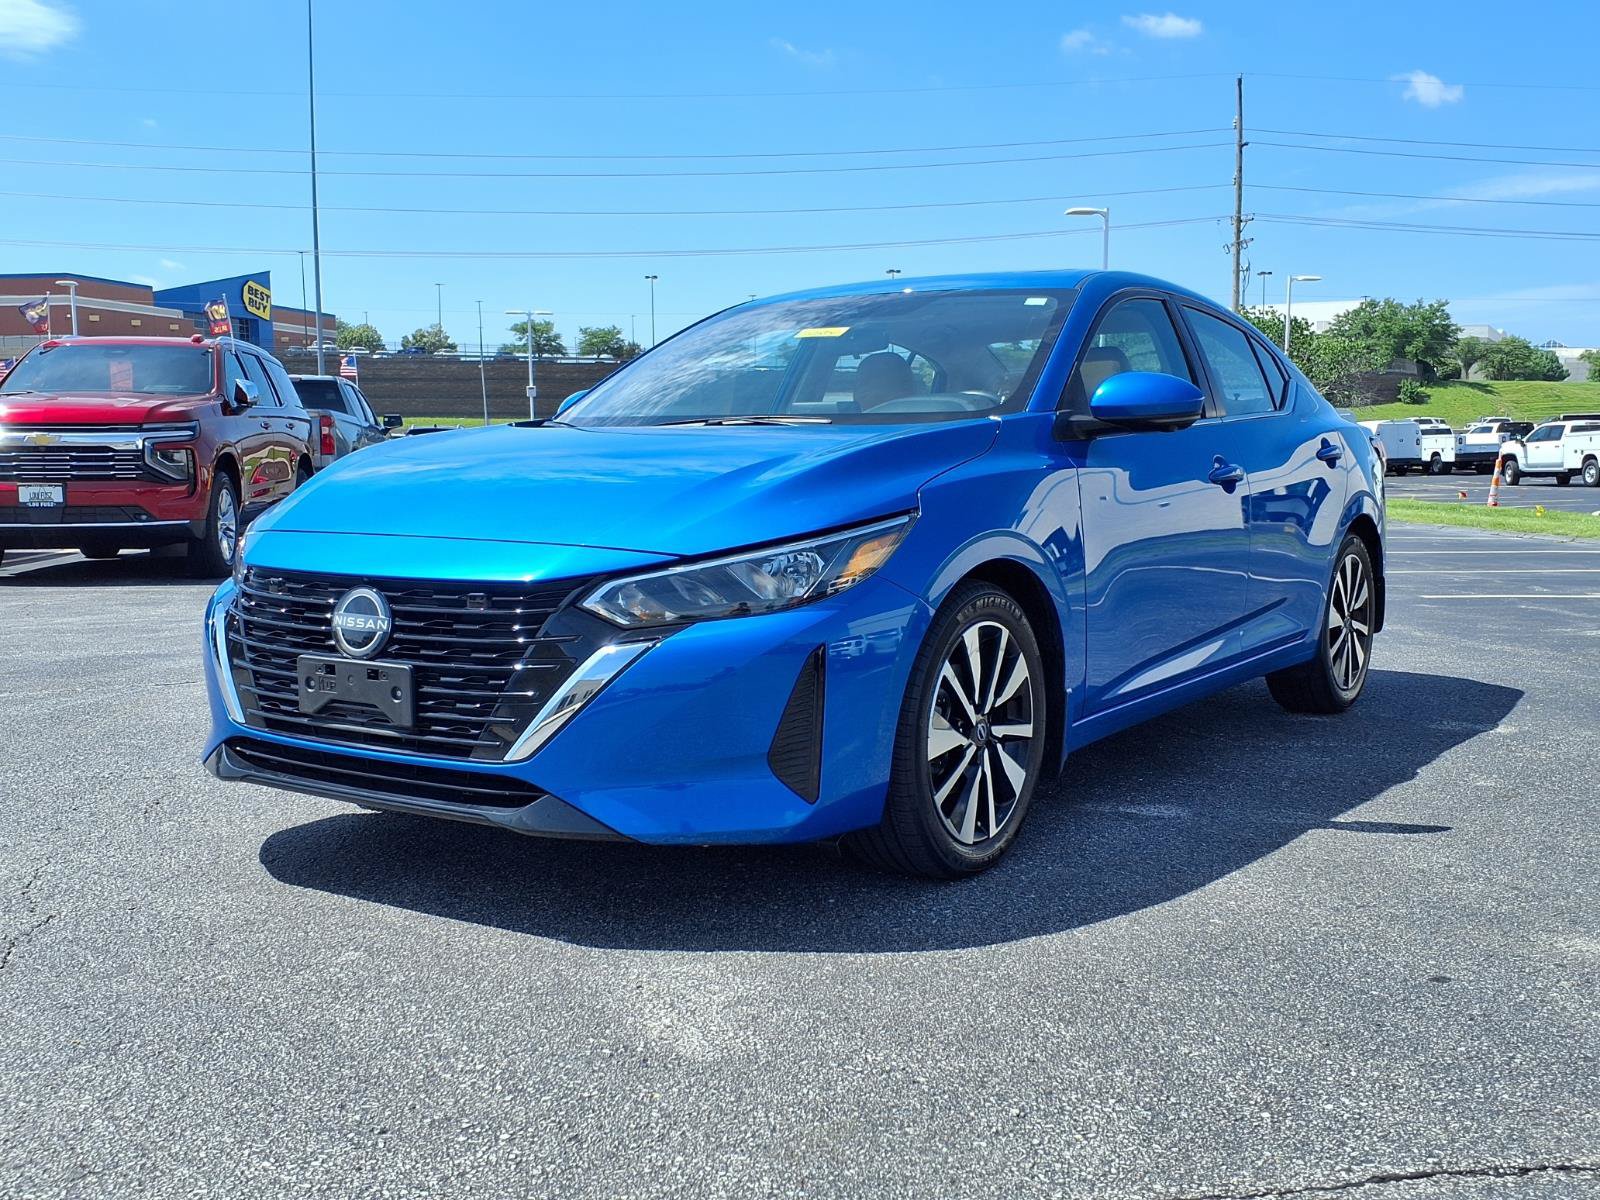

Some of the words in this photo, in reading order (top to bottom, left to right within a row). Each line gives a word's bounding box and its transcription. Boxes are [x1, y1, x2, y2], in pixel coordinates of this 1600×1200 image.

[248, 285, 271, 303] BEST
[248, 297, 268, 313] BUY
[976, 597, 1022, 617] MICHELIN
[333, 614, 387, 629] NISSAN
